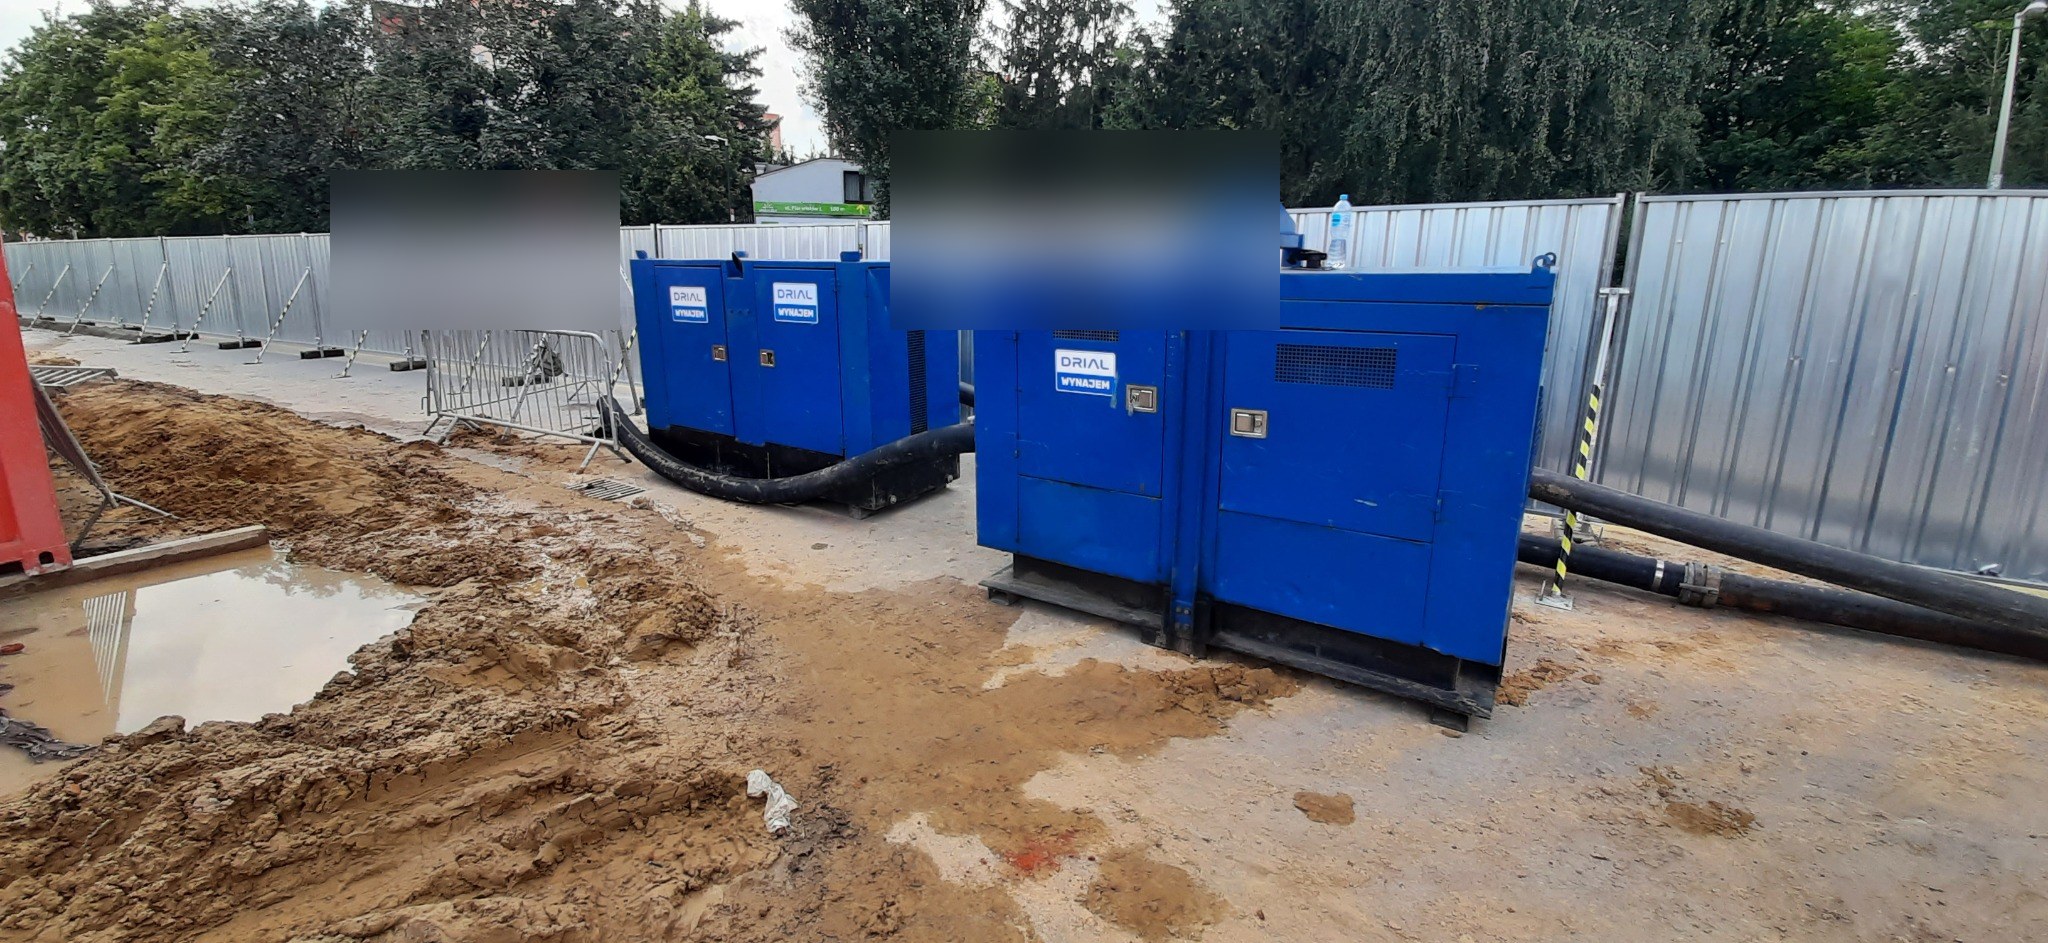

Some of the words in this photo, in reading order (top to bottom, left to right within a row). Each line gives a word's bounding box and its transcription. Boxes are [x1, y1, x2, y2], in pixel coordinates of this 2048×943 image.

[673, 292, 702, 302] DRIAL
[777, 289, 812, 301] DRIAL
[675, 308, 705, 318] WYNAJEM
[778, 307, 814, 318] WYNAJEM
[1061, 356, 1109, 370] DRIAL
[1061, 376, 1110, 390] WYNAJEM
